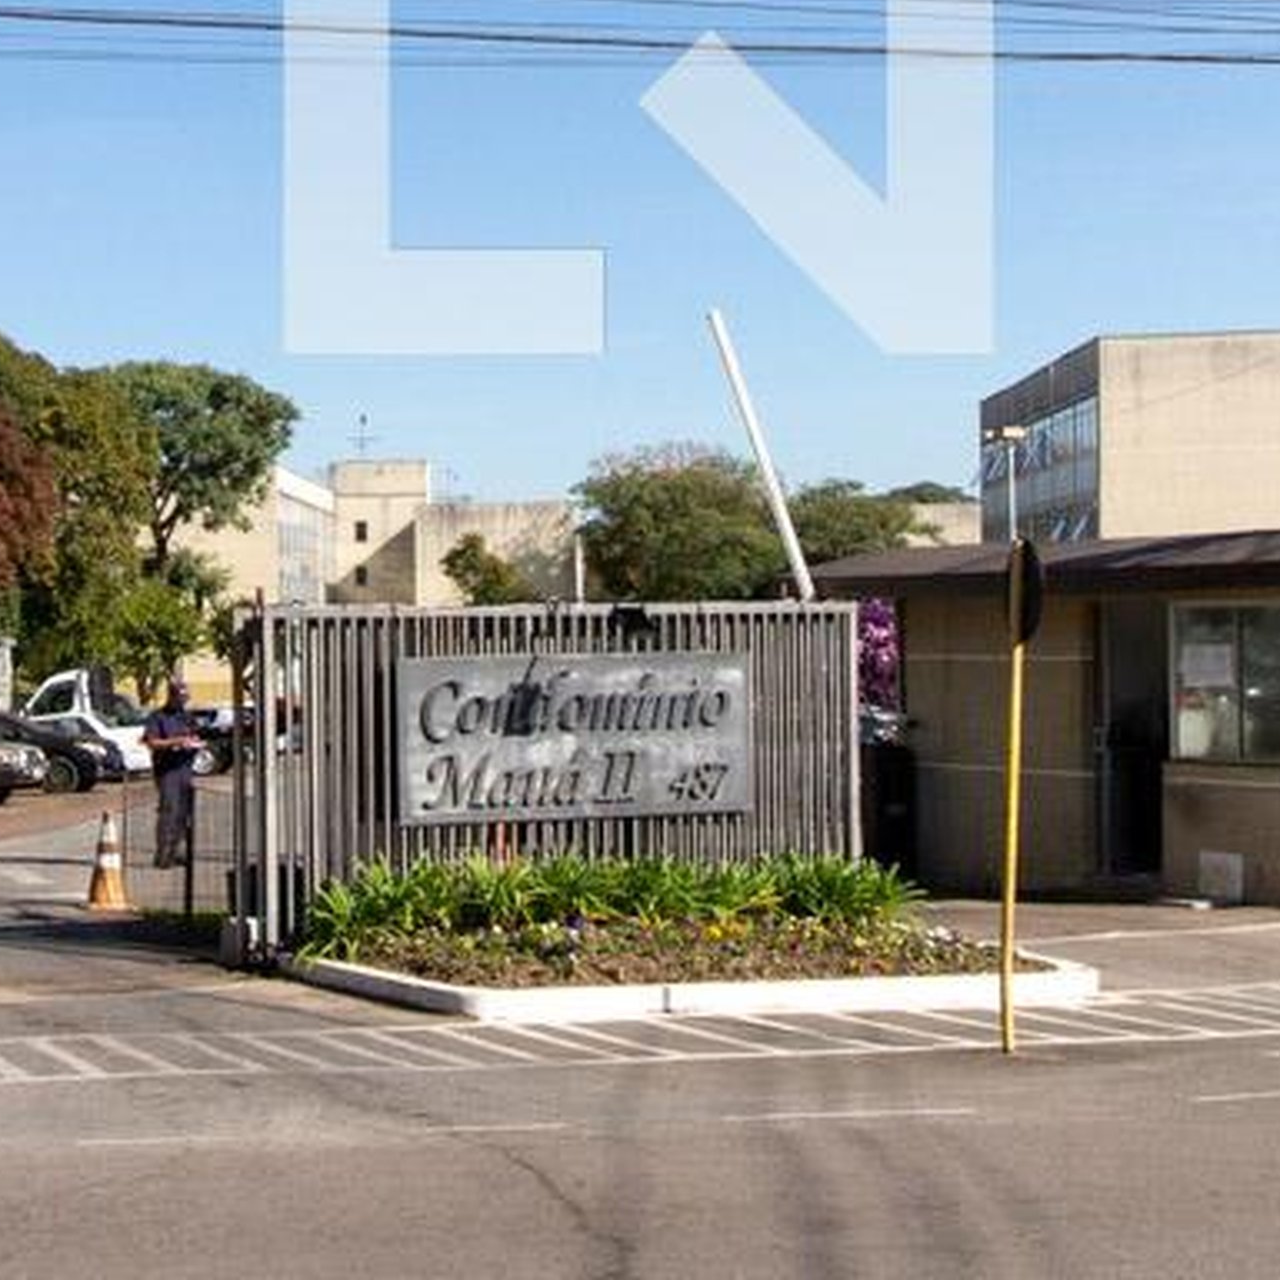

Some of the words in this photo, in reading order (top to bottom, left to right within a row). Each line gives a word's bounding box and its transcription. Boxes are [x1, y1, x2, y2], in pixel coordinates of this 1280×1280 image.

[421, 747, 582, 811] Mauá
[592, 751, 637, 804] II
[668, 762, 729, 801] 487
